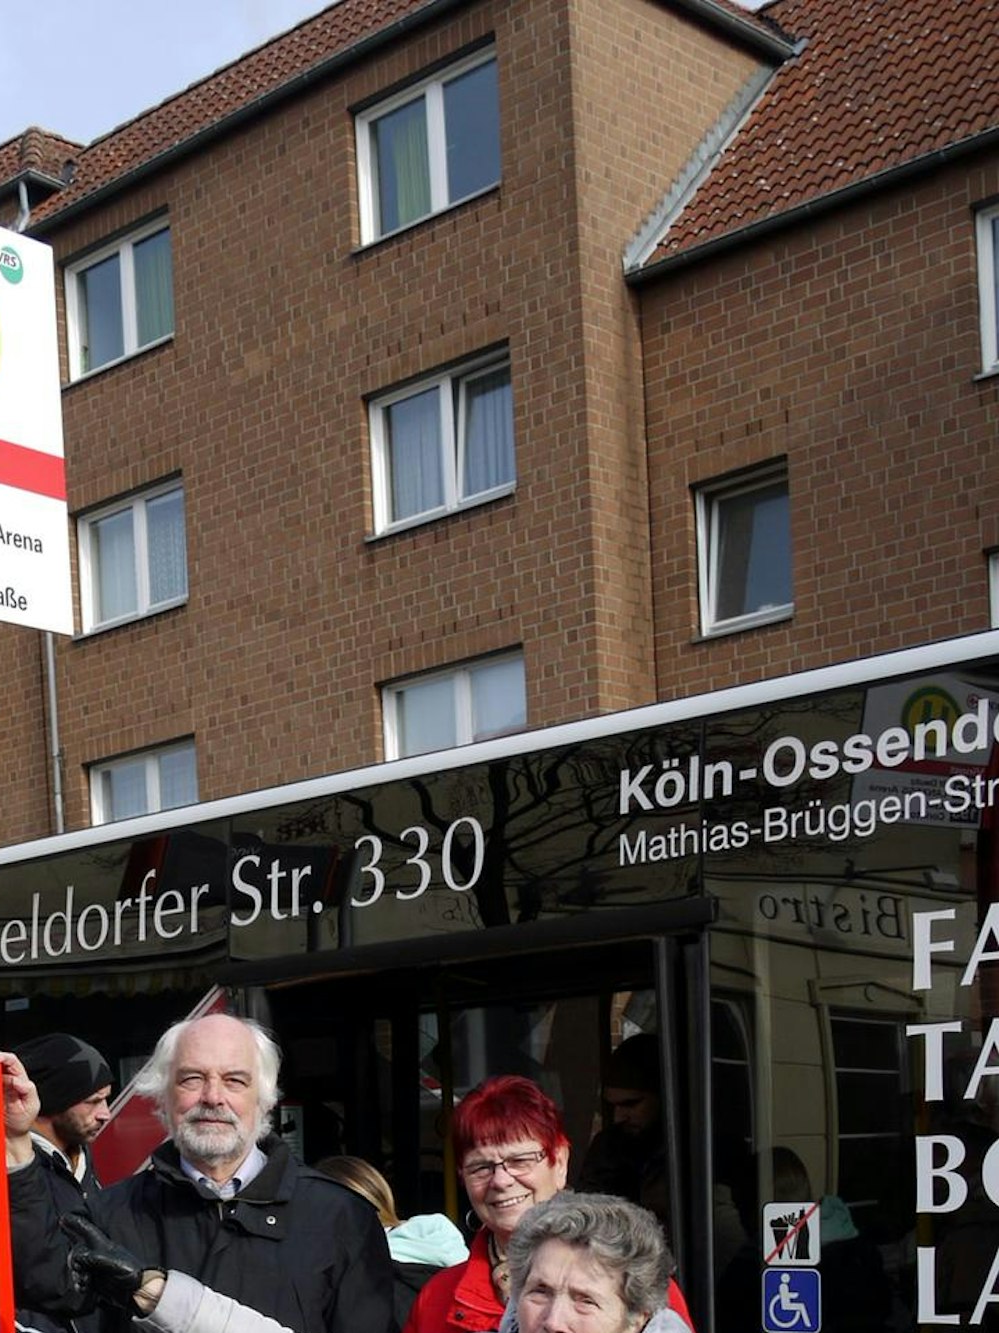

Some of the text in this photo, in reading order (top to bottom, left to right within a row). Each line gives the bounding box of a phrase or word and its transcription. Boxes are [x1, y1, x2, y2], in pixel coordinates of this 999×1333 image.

[618, 698, 999, 815] Köln-Ossend
[230, 853, 324, 929] Str.
[350, 815, 485, 908] 330
